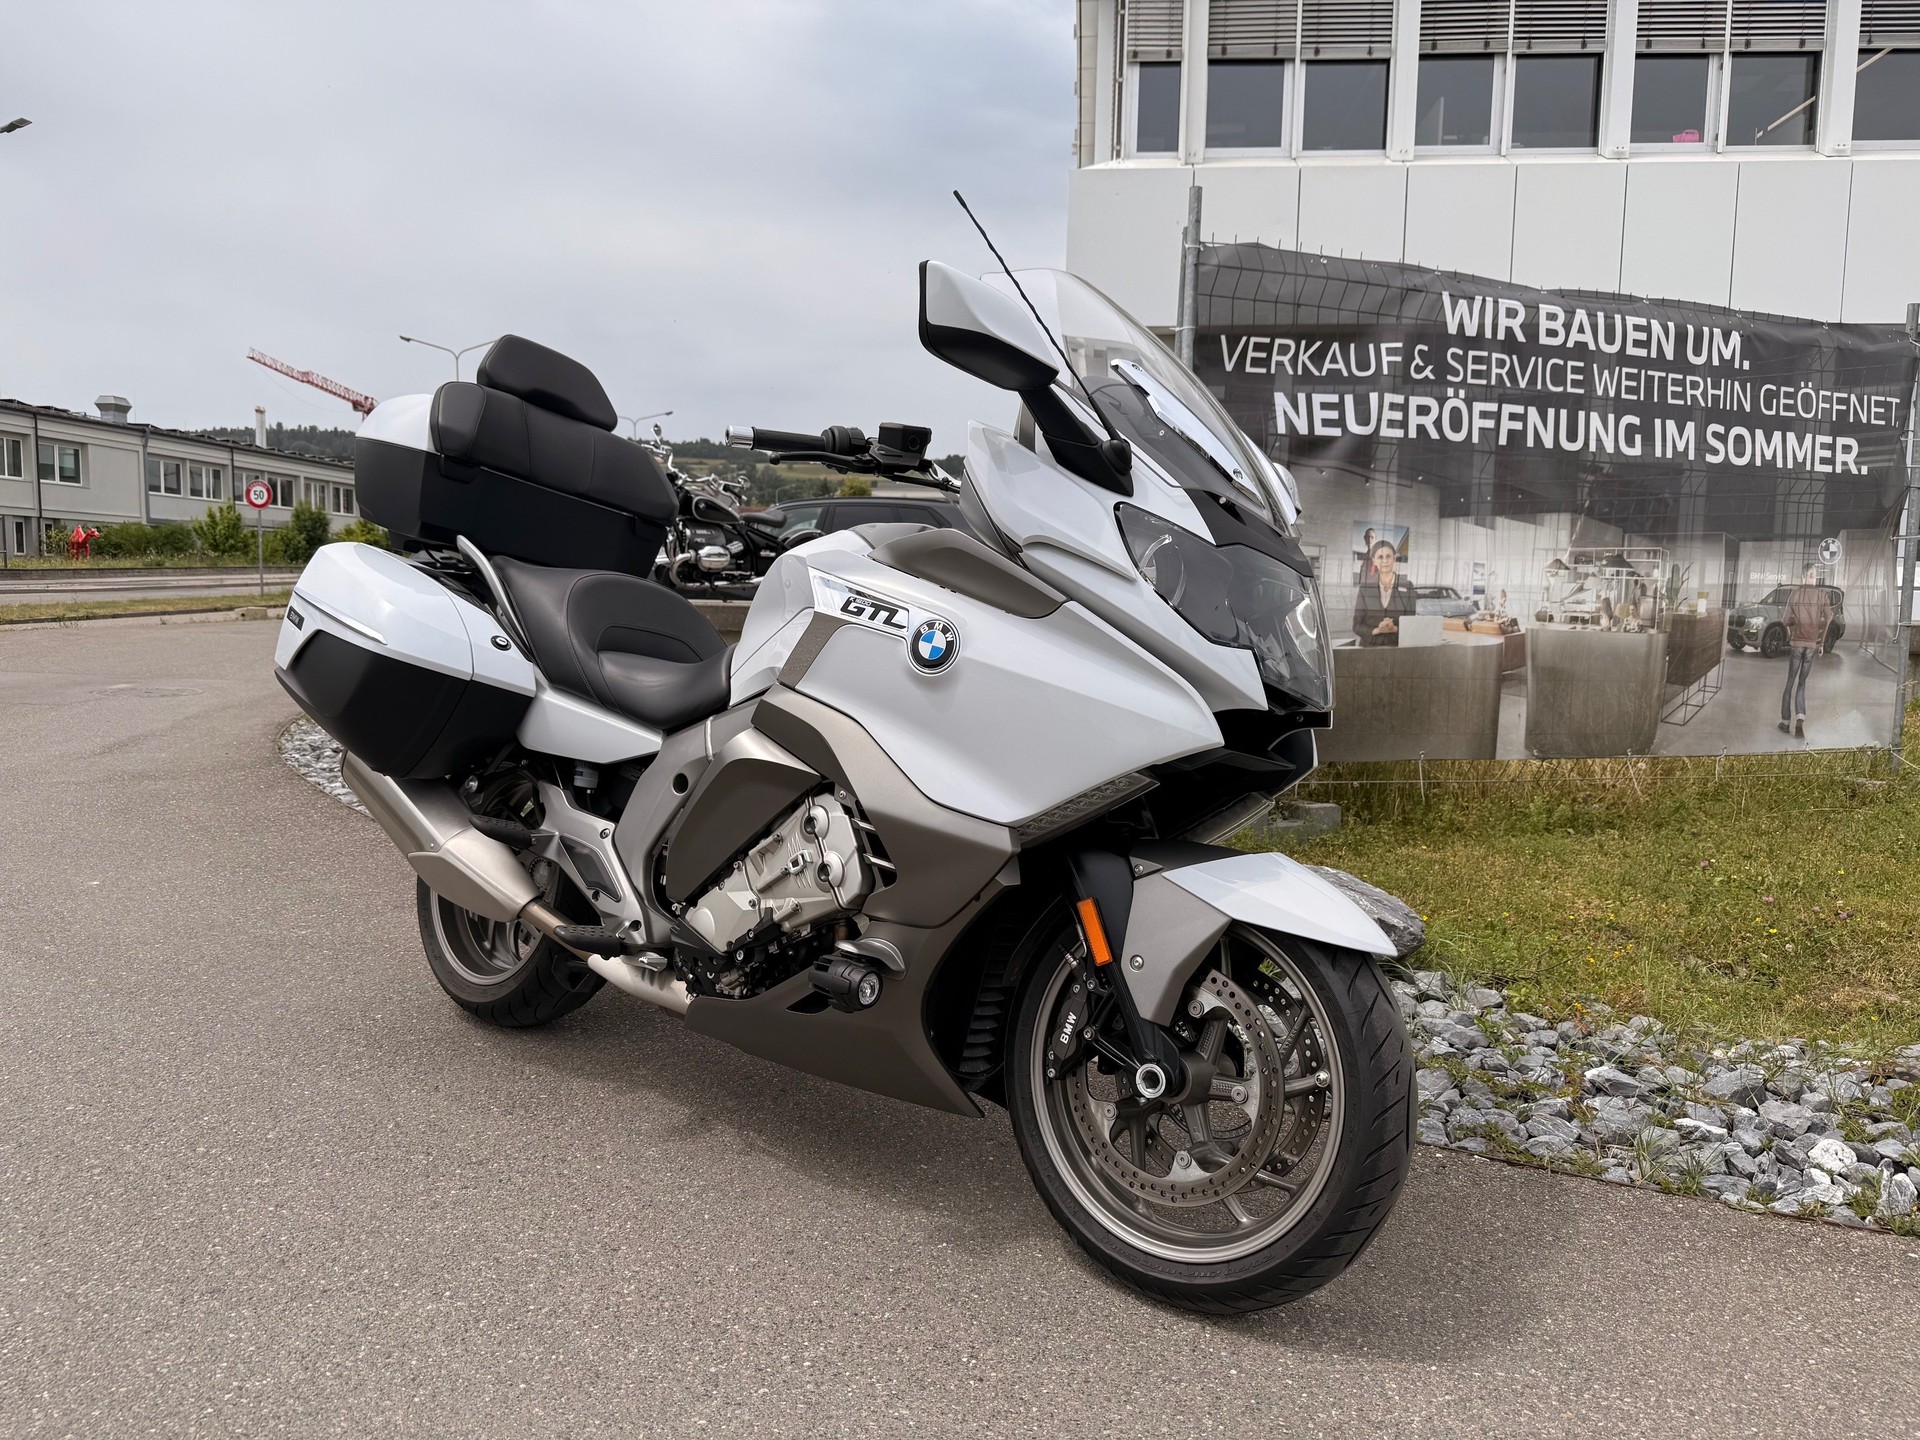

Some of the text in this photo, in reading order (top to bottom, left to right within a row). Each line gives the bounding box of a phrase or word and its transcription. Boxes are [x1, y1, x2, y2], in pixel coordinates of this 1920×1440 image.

[1442, 291, 1750, 370] WIR BAUEN UM.
[1220, 334, 1900, 428] VERKAUF & SERVICE WEITERHIN GEÖFFNET,
[1273, 387, 1869, 476] NEUERÖFFNUNG IM SOMMER.
[253, 489, 264, 500] 50
[840, 596, 907, 630] GTL
[920, 622, 954, 642] BMW
[1060, 1011, 1077, 1044] BMW
